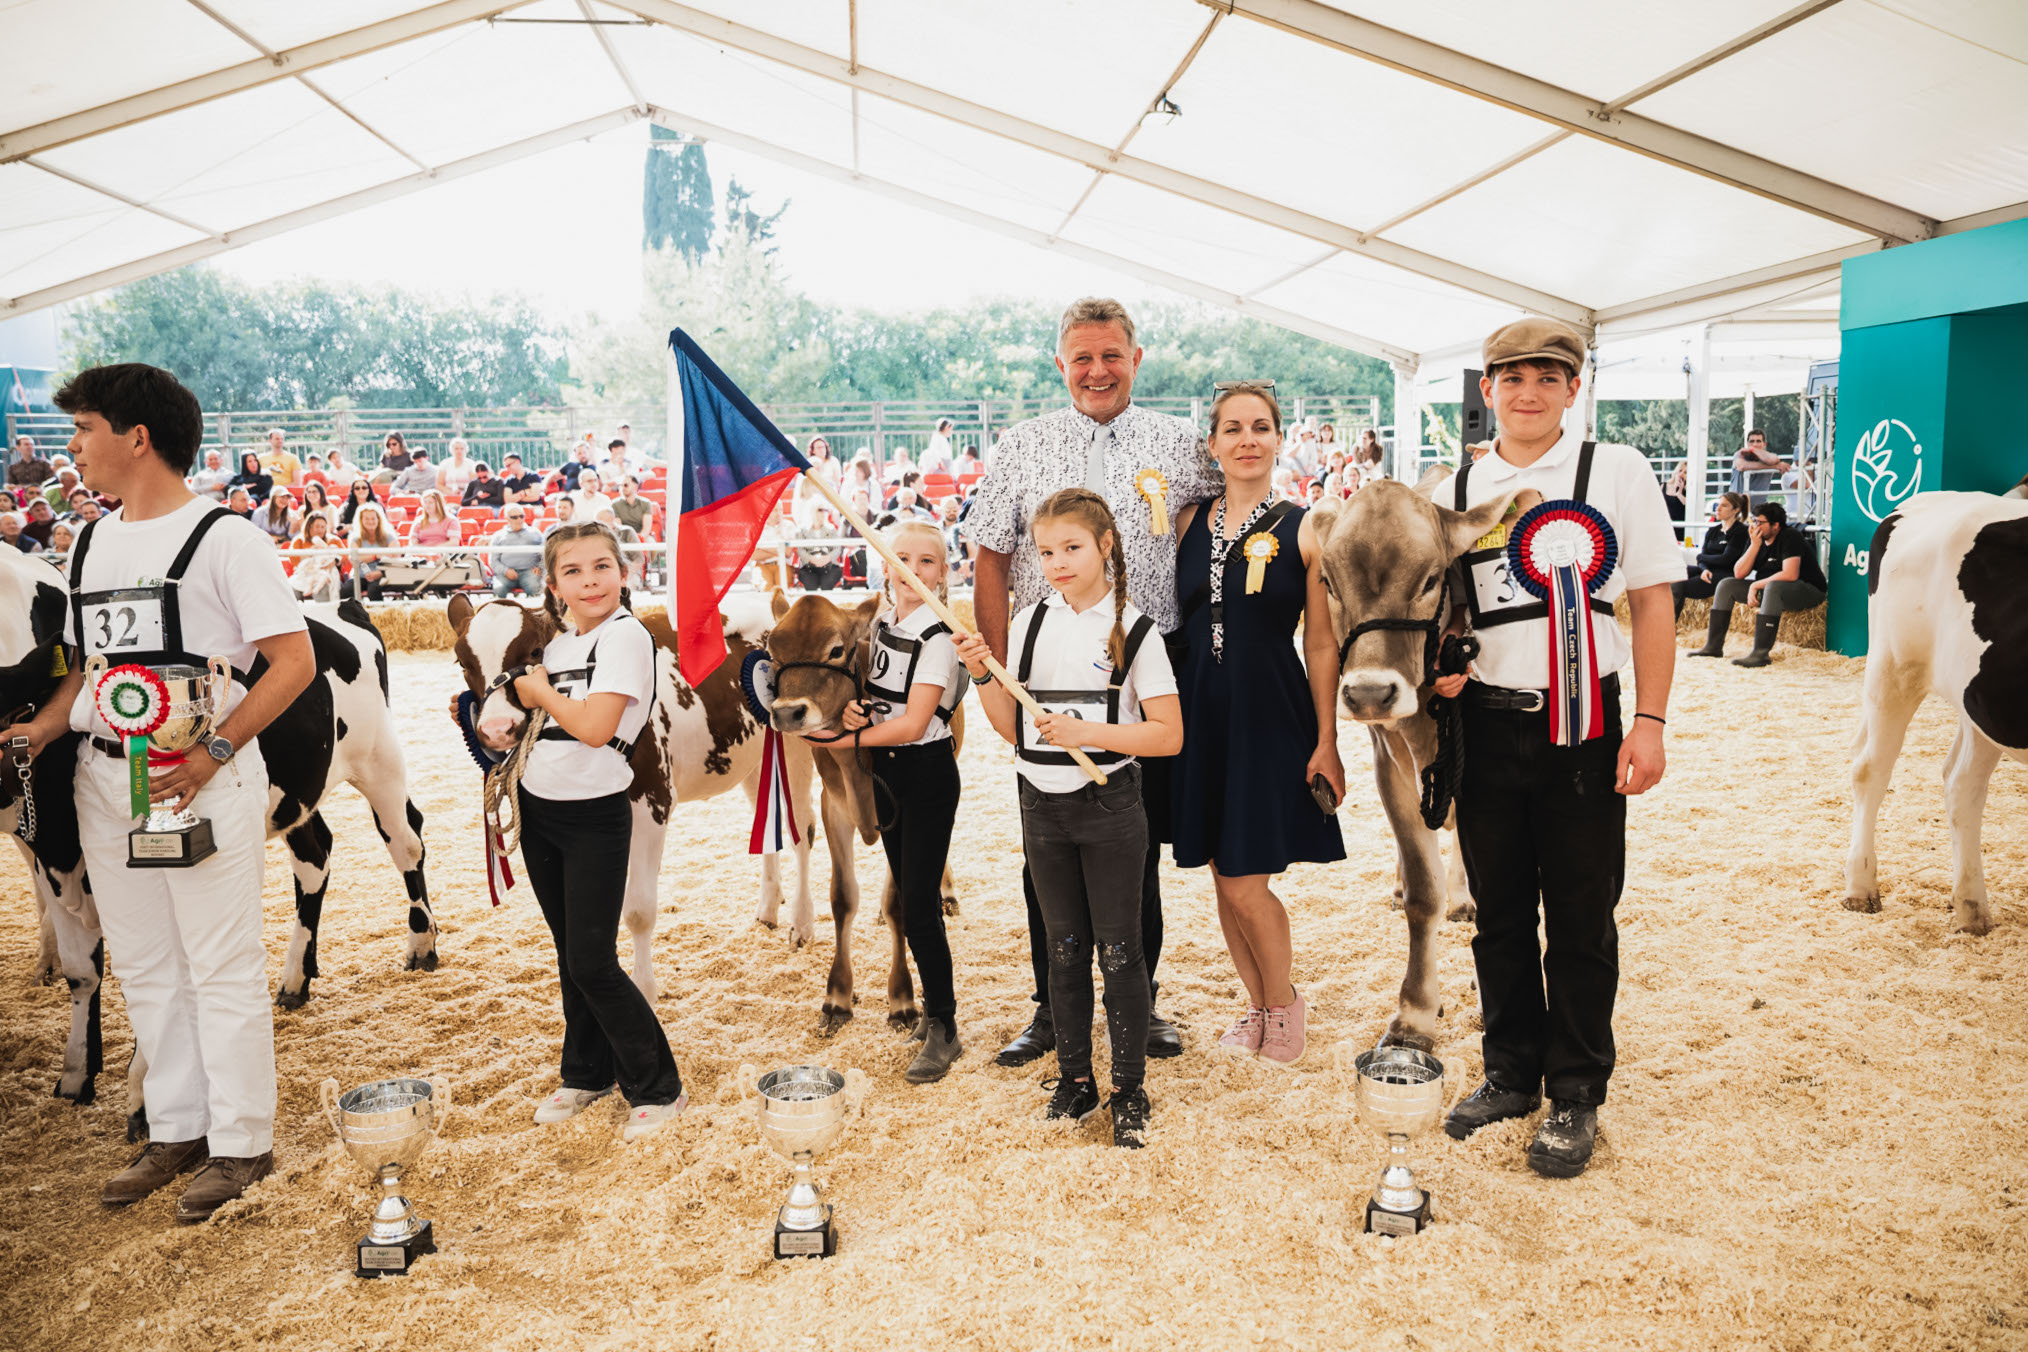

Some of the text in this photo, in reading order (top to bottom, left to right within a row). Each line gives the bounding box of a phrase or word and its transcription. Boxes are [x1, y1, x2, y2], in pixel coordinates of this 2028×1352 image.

[1843, 543, 1870, 576] Ag
[1494, 562, 1518, 603] 3
[95, 607, 139, 649] 32
[1567, 607, 1578, 699] Team Czech Republic
[134, 756, 145, 795] Team Italy
